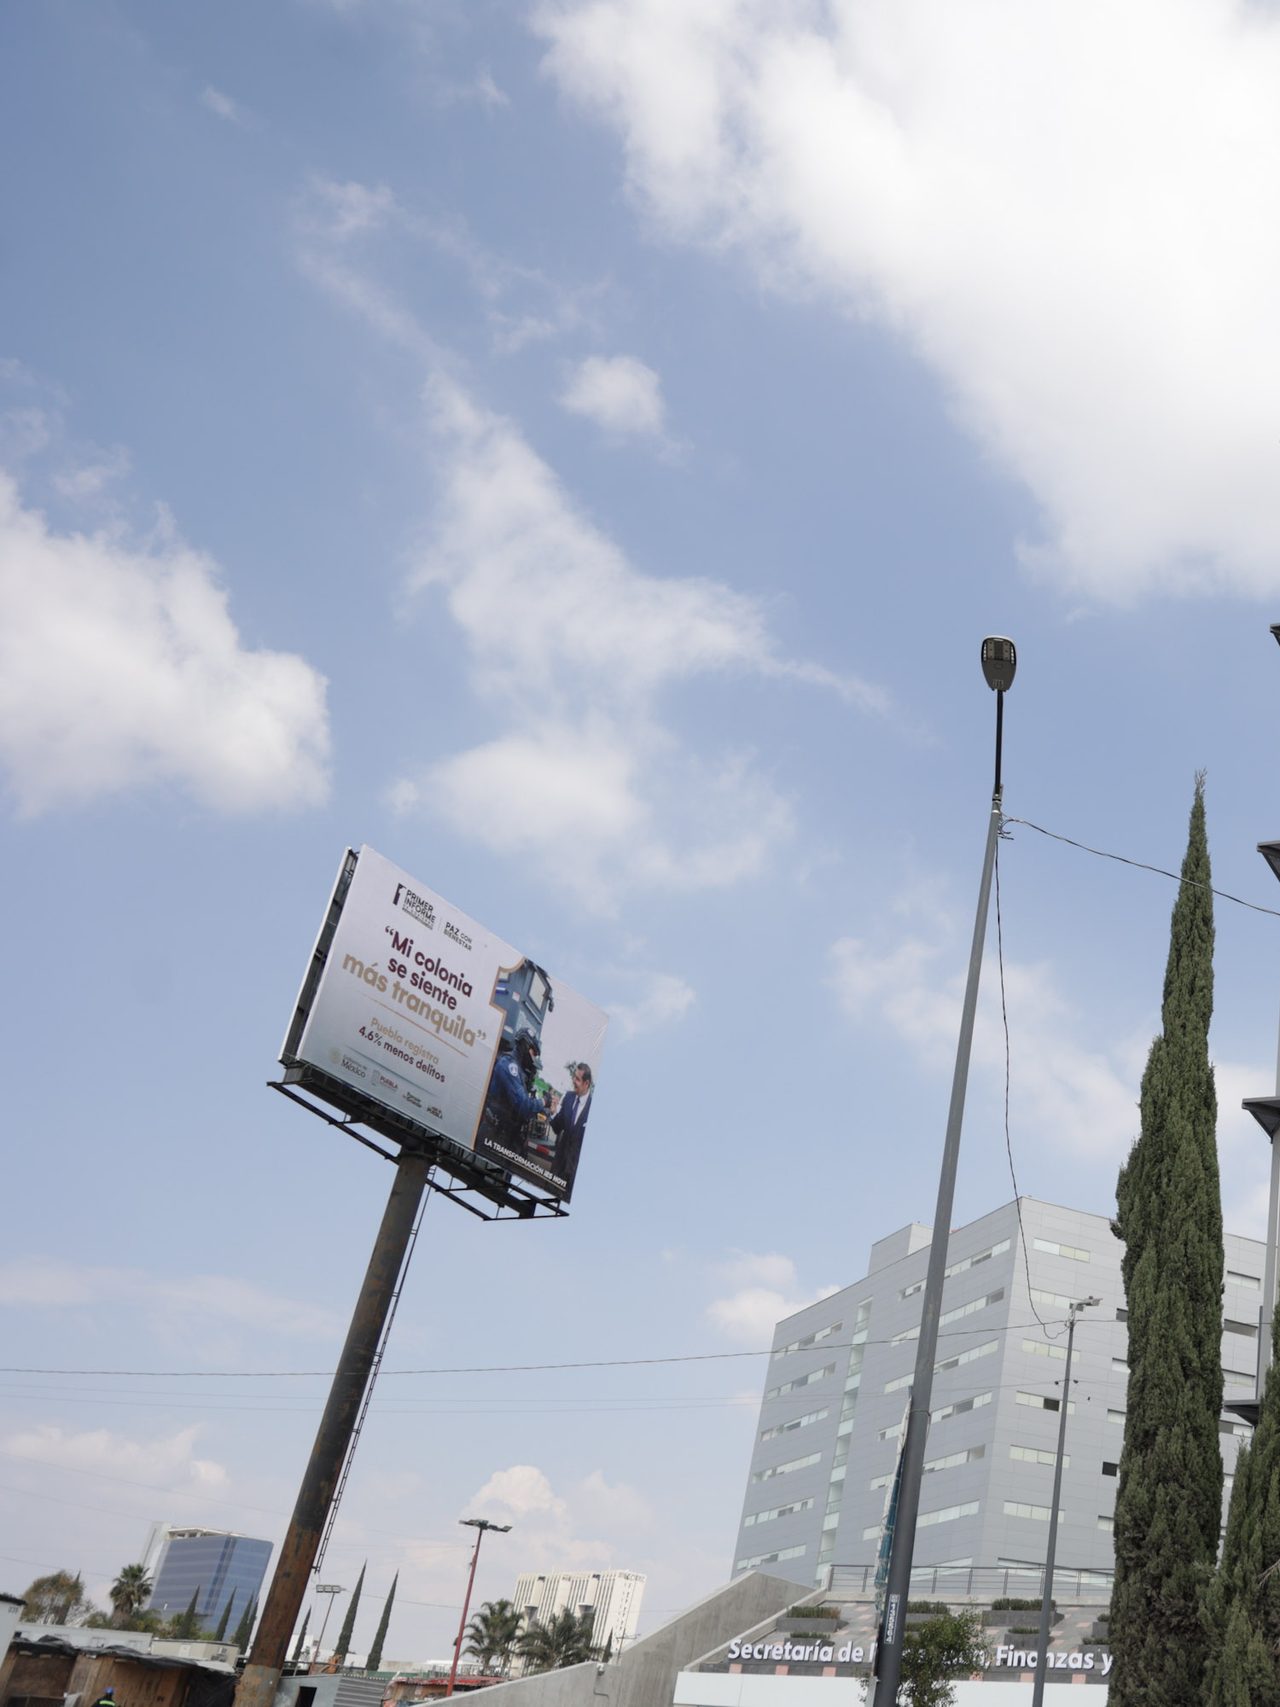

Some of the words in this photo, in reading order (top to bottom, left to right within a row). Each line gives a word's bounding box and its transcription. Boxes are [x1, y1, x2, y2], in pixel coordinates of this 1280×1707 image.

[404, 896, 437, 923] INFORME
[406, 889, 434, 913] PRIMER
[445, 921, 460, 935] PAZ
[342, 953, 389, 993] más
[388, 957, 407, 978] se
[409, 970, 457, 1010] siente
[414, 951, 473, 997] colonia
[358, 1026, 382, 1046] 4.6%
[383, 1042, 415, 1065] menos
[415, 1058, 446, 1083] delitos
[370, 1017, 403, 1045] Puebla
[404, 1039, 440, 1065] registra
[484, 1137, 493, 1148] LA
[728, 1638, 834, 1662] Secretaría
[837, 1640, 864, 1663] de
[1101, 1652, 1113, 1677] y
